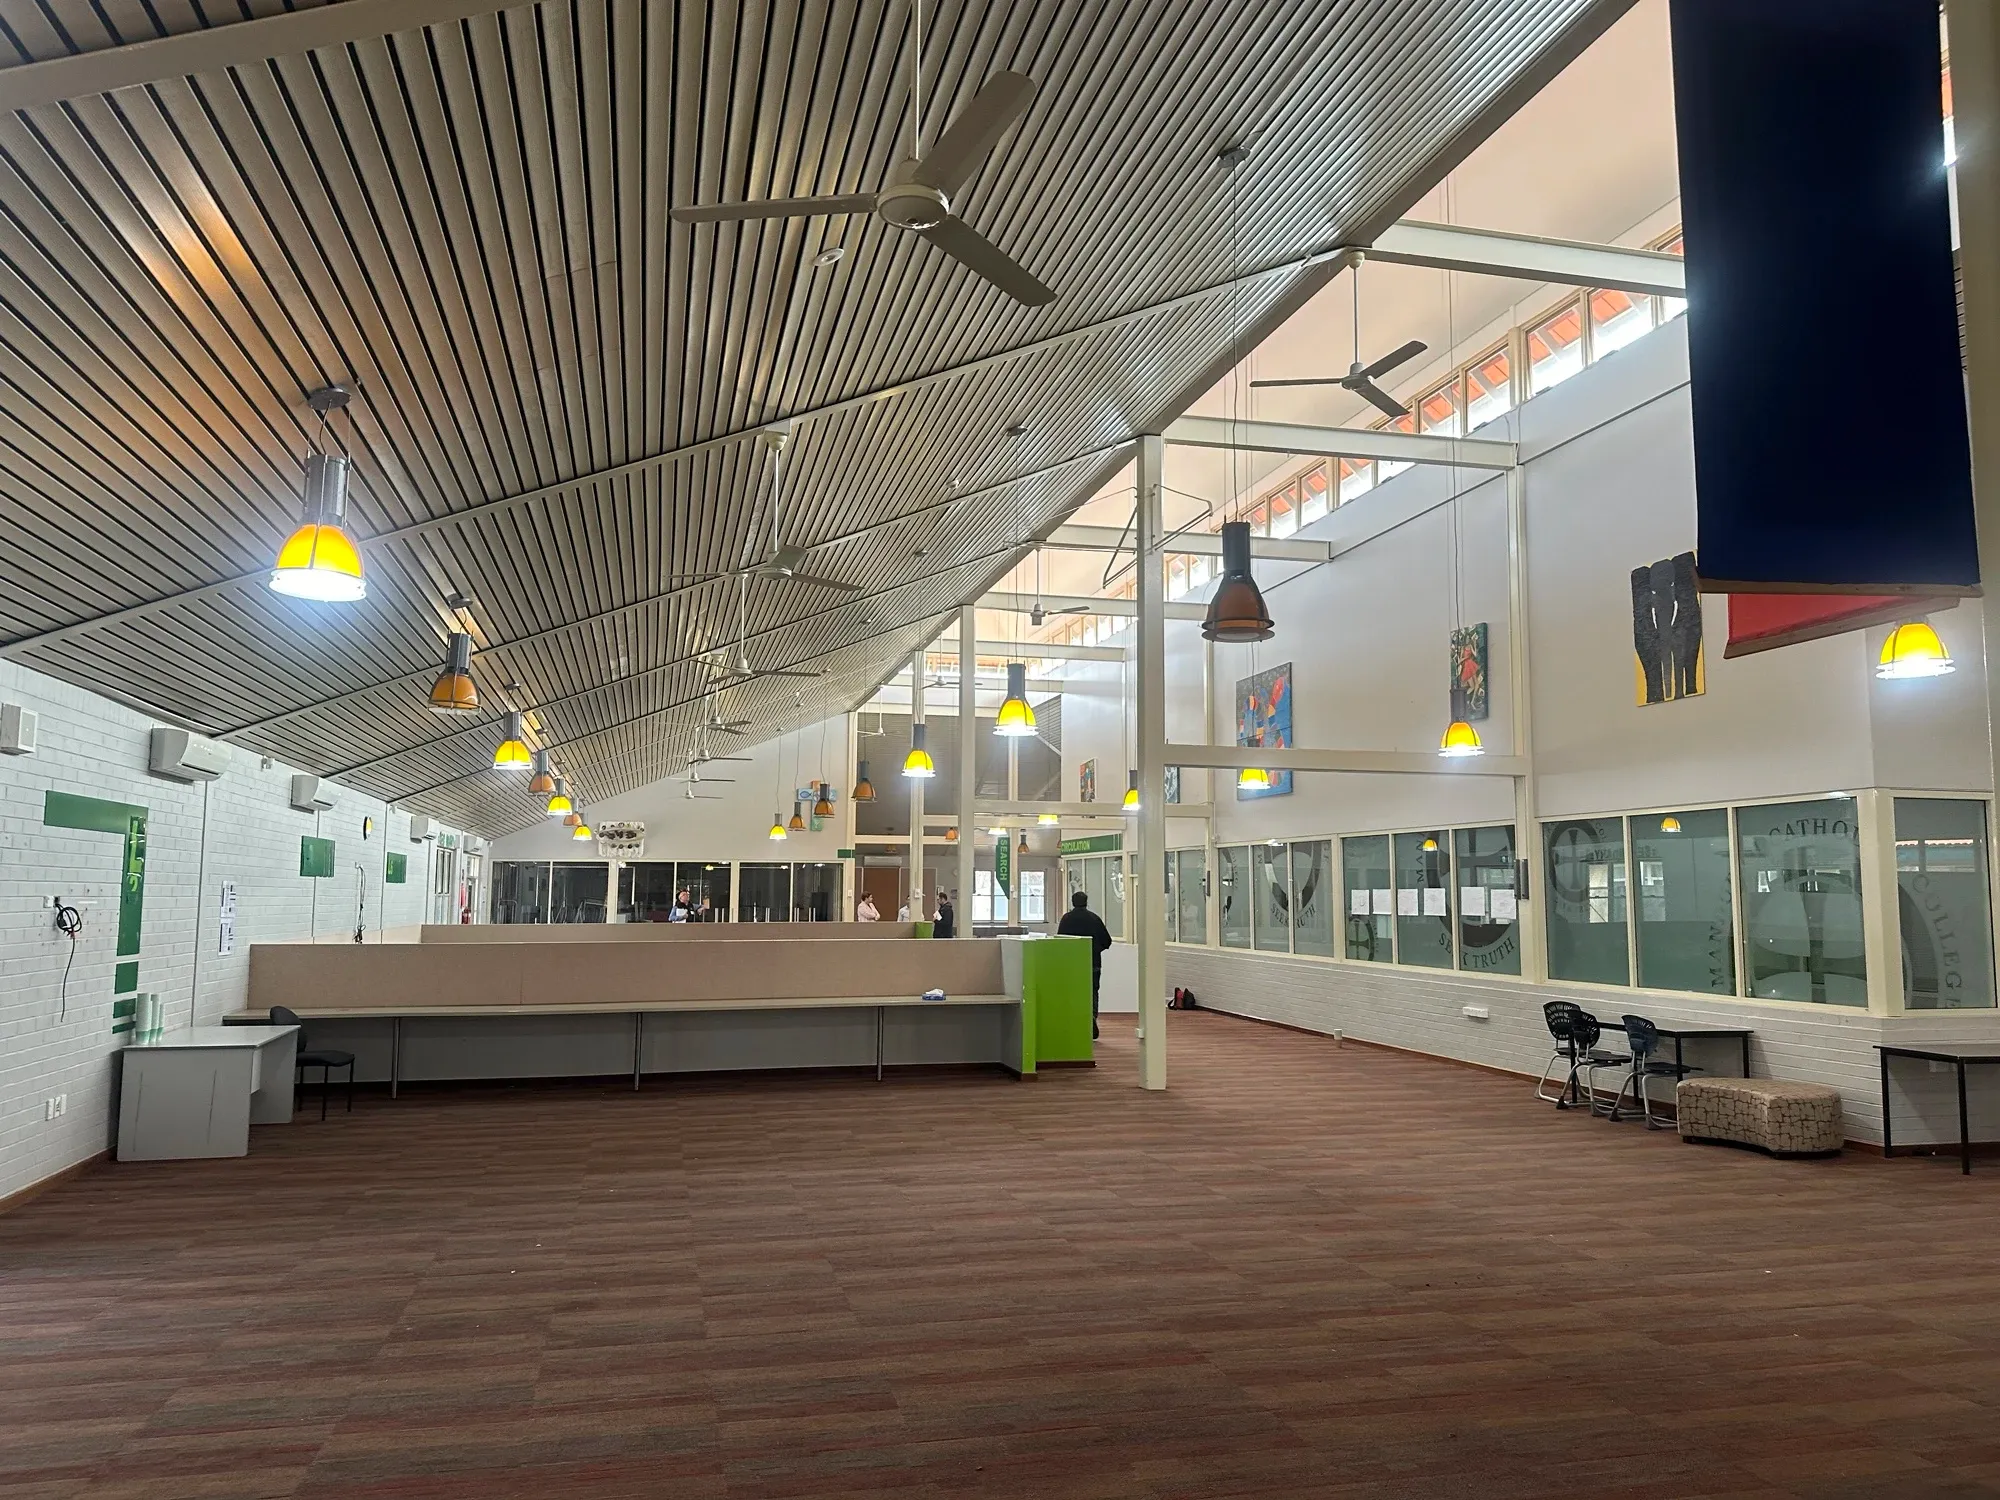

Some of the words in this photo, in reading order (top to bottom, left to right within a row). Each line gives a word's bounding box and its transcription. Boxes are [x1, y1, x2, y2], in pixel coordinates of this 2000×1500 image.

[999, 839, 1008, 881] SEARCH
[1061, 839, 1091, 853] CIRCULATION
[1472, 936, 1515, 969] TRUTH
